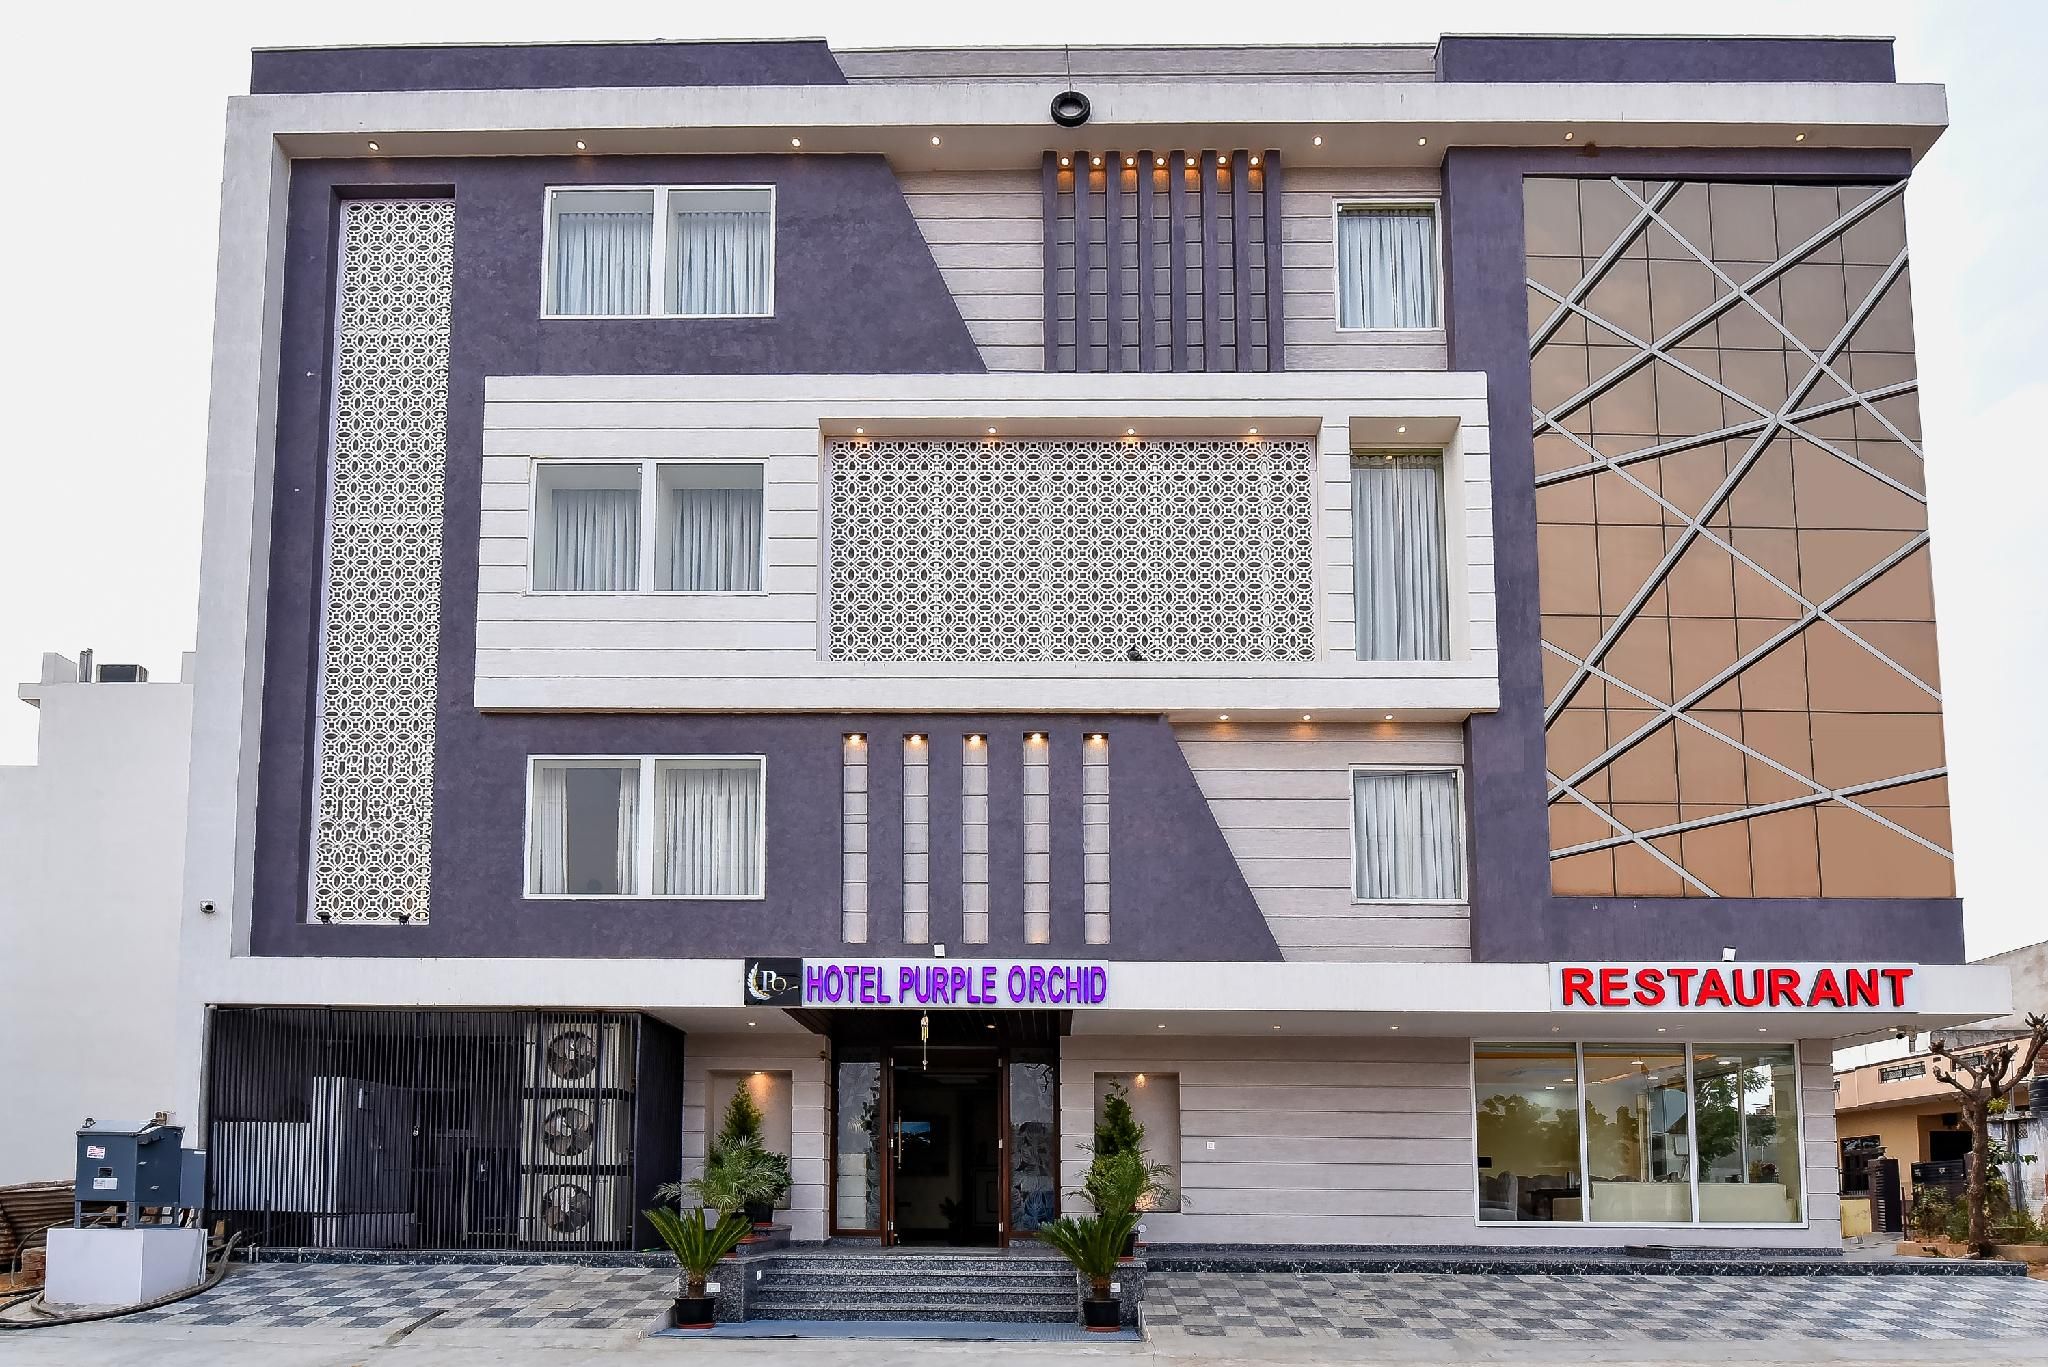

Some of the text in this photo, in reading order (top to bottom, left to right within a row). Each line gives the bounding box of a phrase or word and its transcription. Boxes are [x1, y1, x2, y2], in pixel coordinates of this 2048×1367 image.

[806, 965, 1107, 1005] HOTEL PURPLE ORCHID
[1561, 968, 1914, 1008] RESTAURANT
